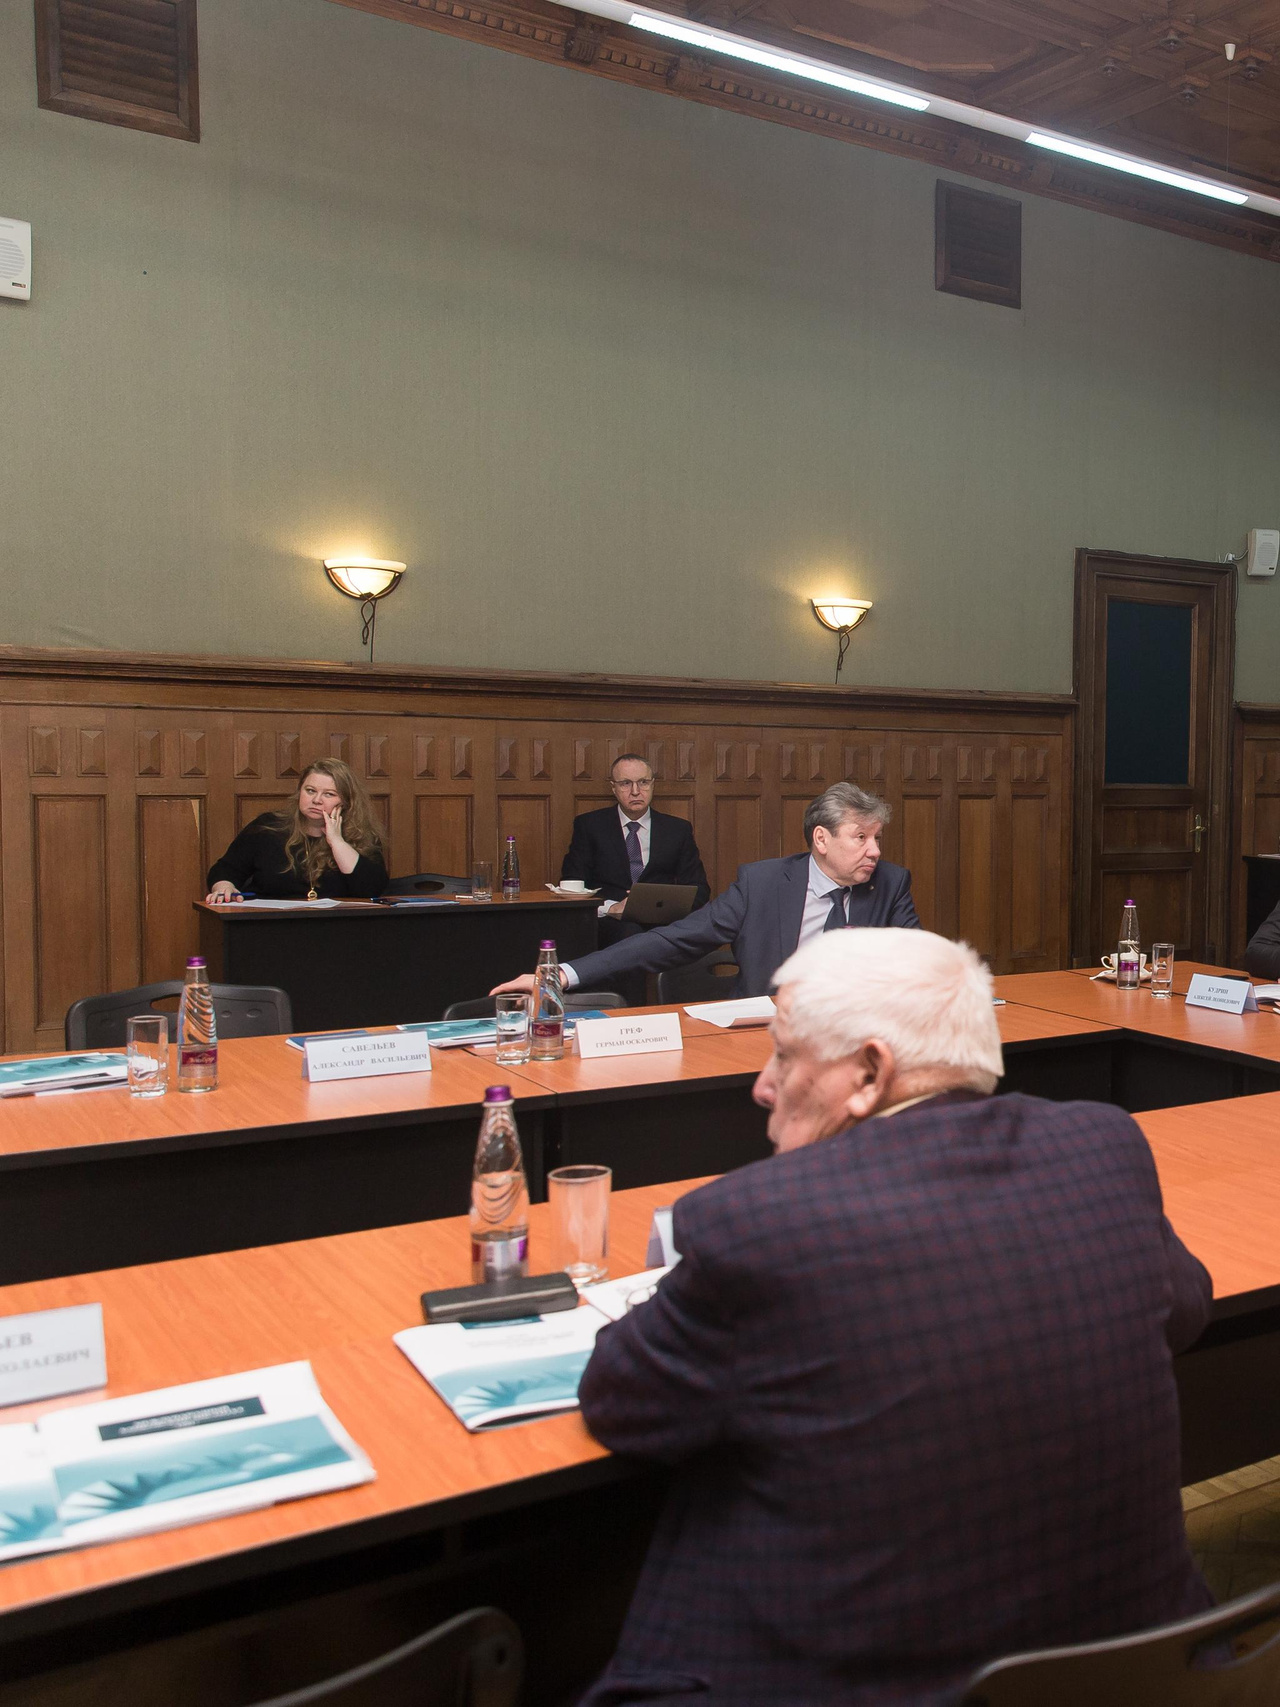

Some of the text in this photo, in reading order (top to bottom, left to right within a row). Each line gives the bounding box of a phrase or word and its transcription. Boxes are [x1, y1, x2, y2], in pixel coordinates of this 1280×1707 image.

[619, 1027, 643, 1035] ГРЕФ
[341, 1042, 396, 1053] САВЕЛЬЕВ
[595, 1036, 668, 1048] ГЕРМАН ОСКАРОВИЧ
[312, 1053, 427, 1070] АЛЕКСАНДР ВАСИЛЬЕВИЧ
